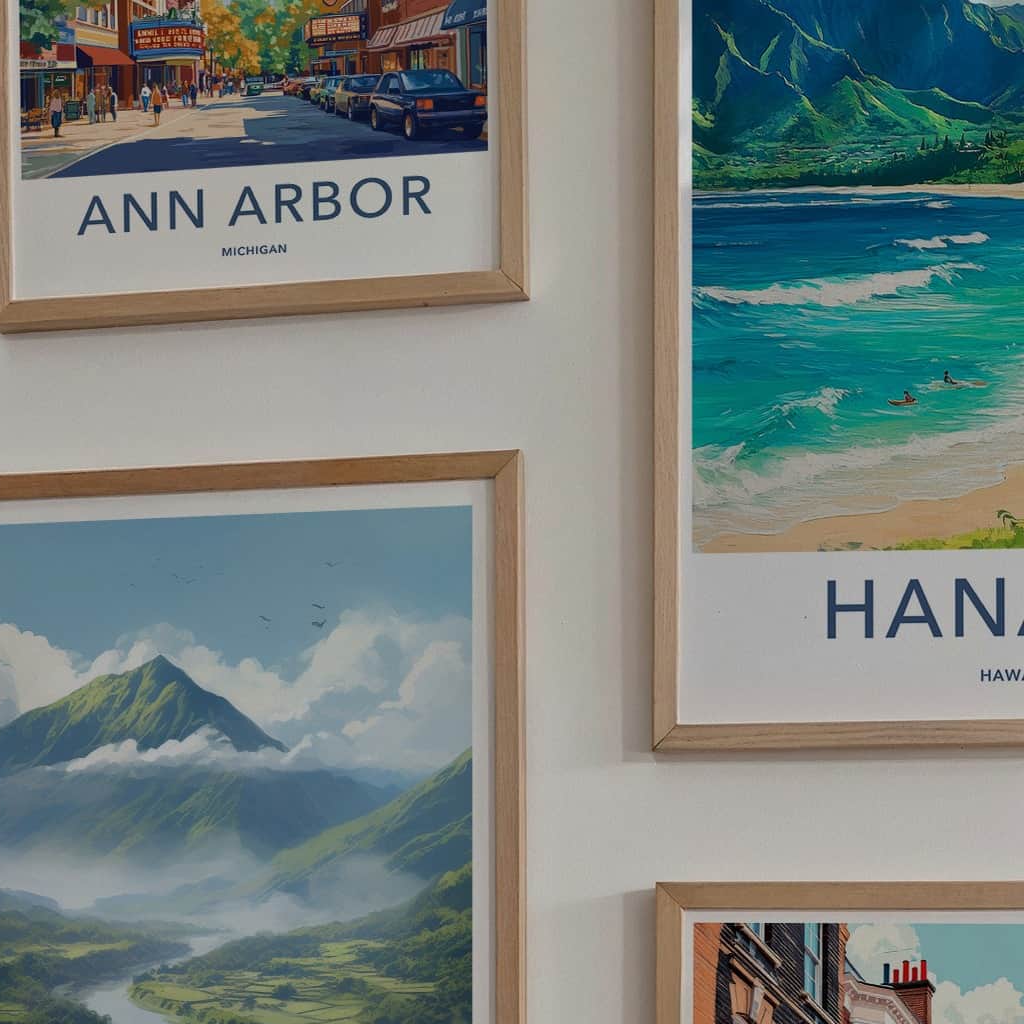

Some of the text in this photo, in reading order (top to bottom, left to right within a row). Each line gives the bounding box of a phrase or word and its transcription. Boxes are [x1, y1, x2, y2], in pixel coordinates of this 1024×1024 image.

[77, 175, 432, 236] ANN ARBOR
[221, 243, 288, 257] MICHIGAN
[827, 577, 1024, 639] HAN
[980, 668, 1024, 682] HAW
